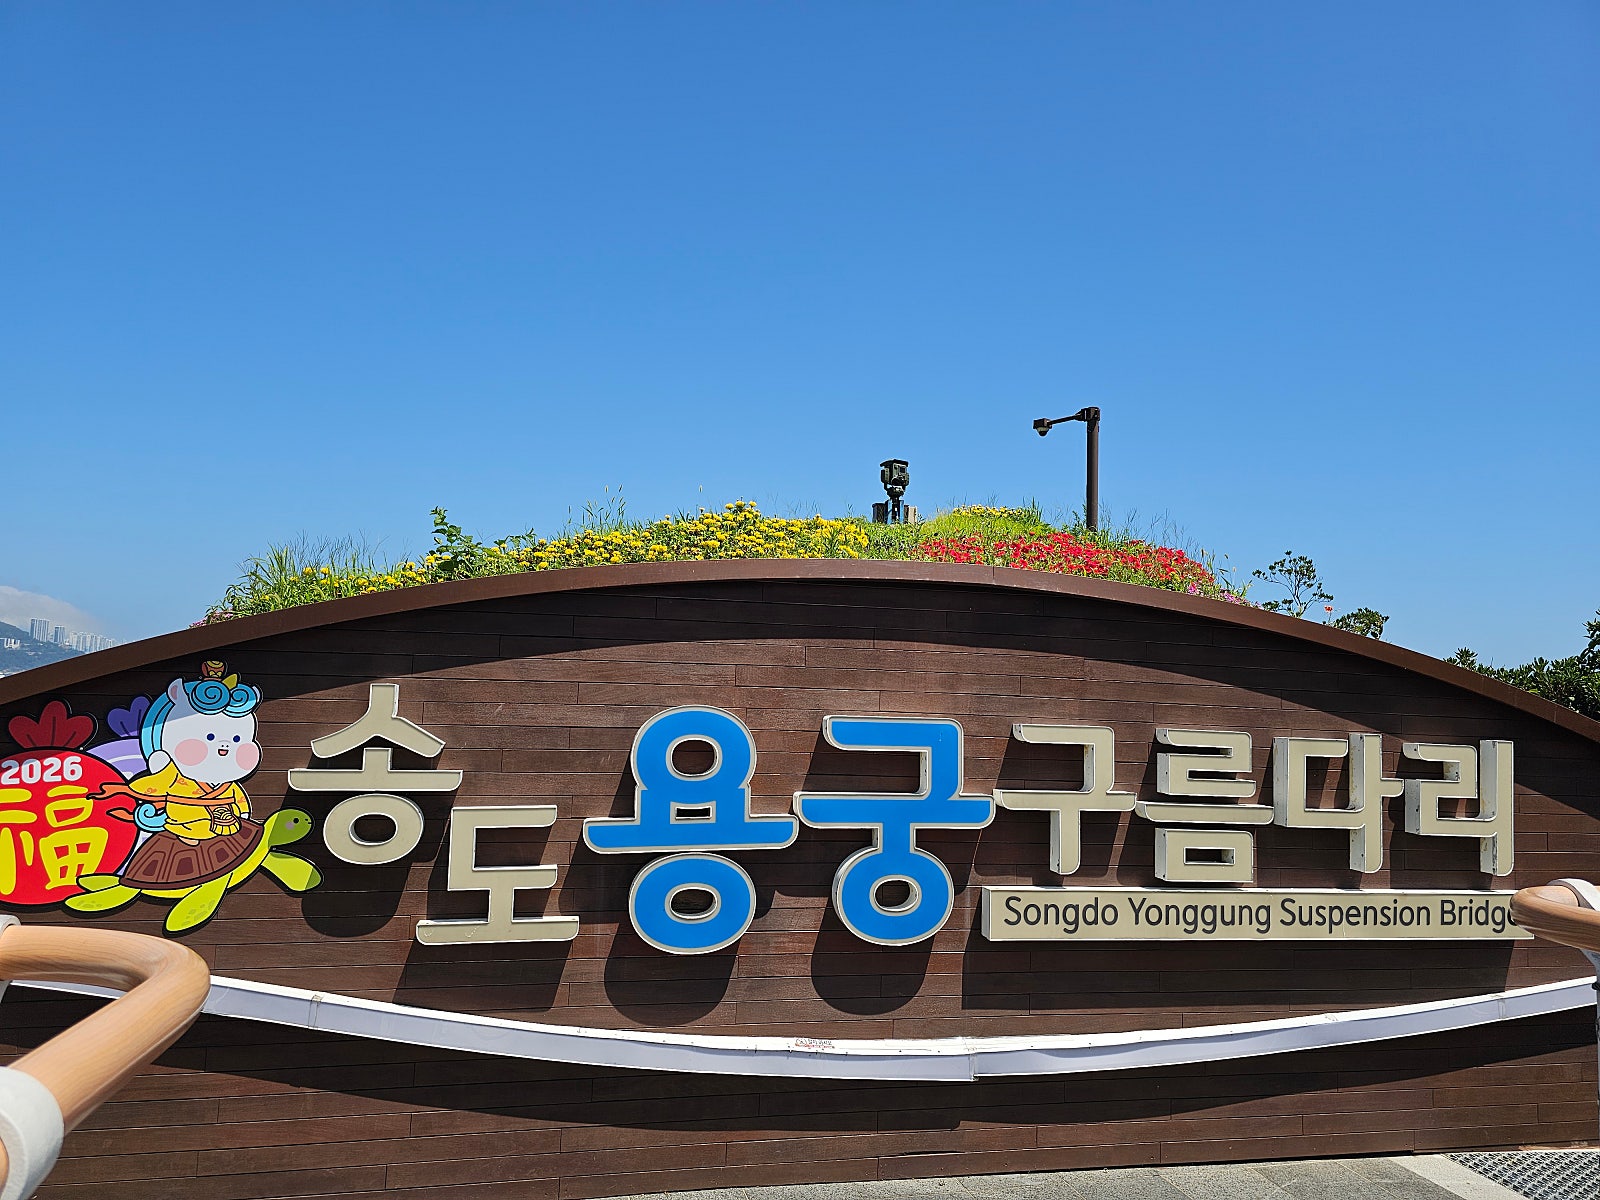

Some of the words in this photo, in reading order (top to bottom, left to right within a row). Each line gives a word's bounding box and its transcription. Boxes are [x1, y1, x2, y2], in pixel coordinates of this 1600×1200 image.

[1, 757, 83, 784] 2026
[0, 785, 109, 896] 福
[287, 683, 580, 946] 송도
[993, 722, 1515, 883] 구름다리
[1003, 896, 1120, 934] Songdo
[1127, 897, 1272, 934] Yonggung
[1279, 898, 1432, 934] Suspension
